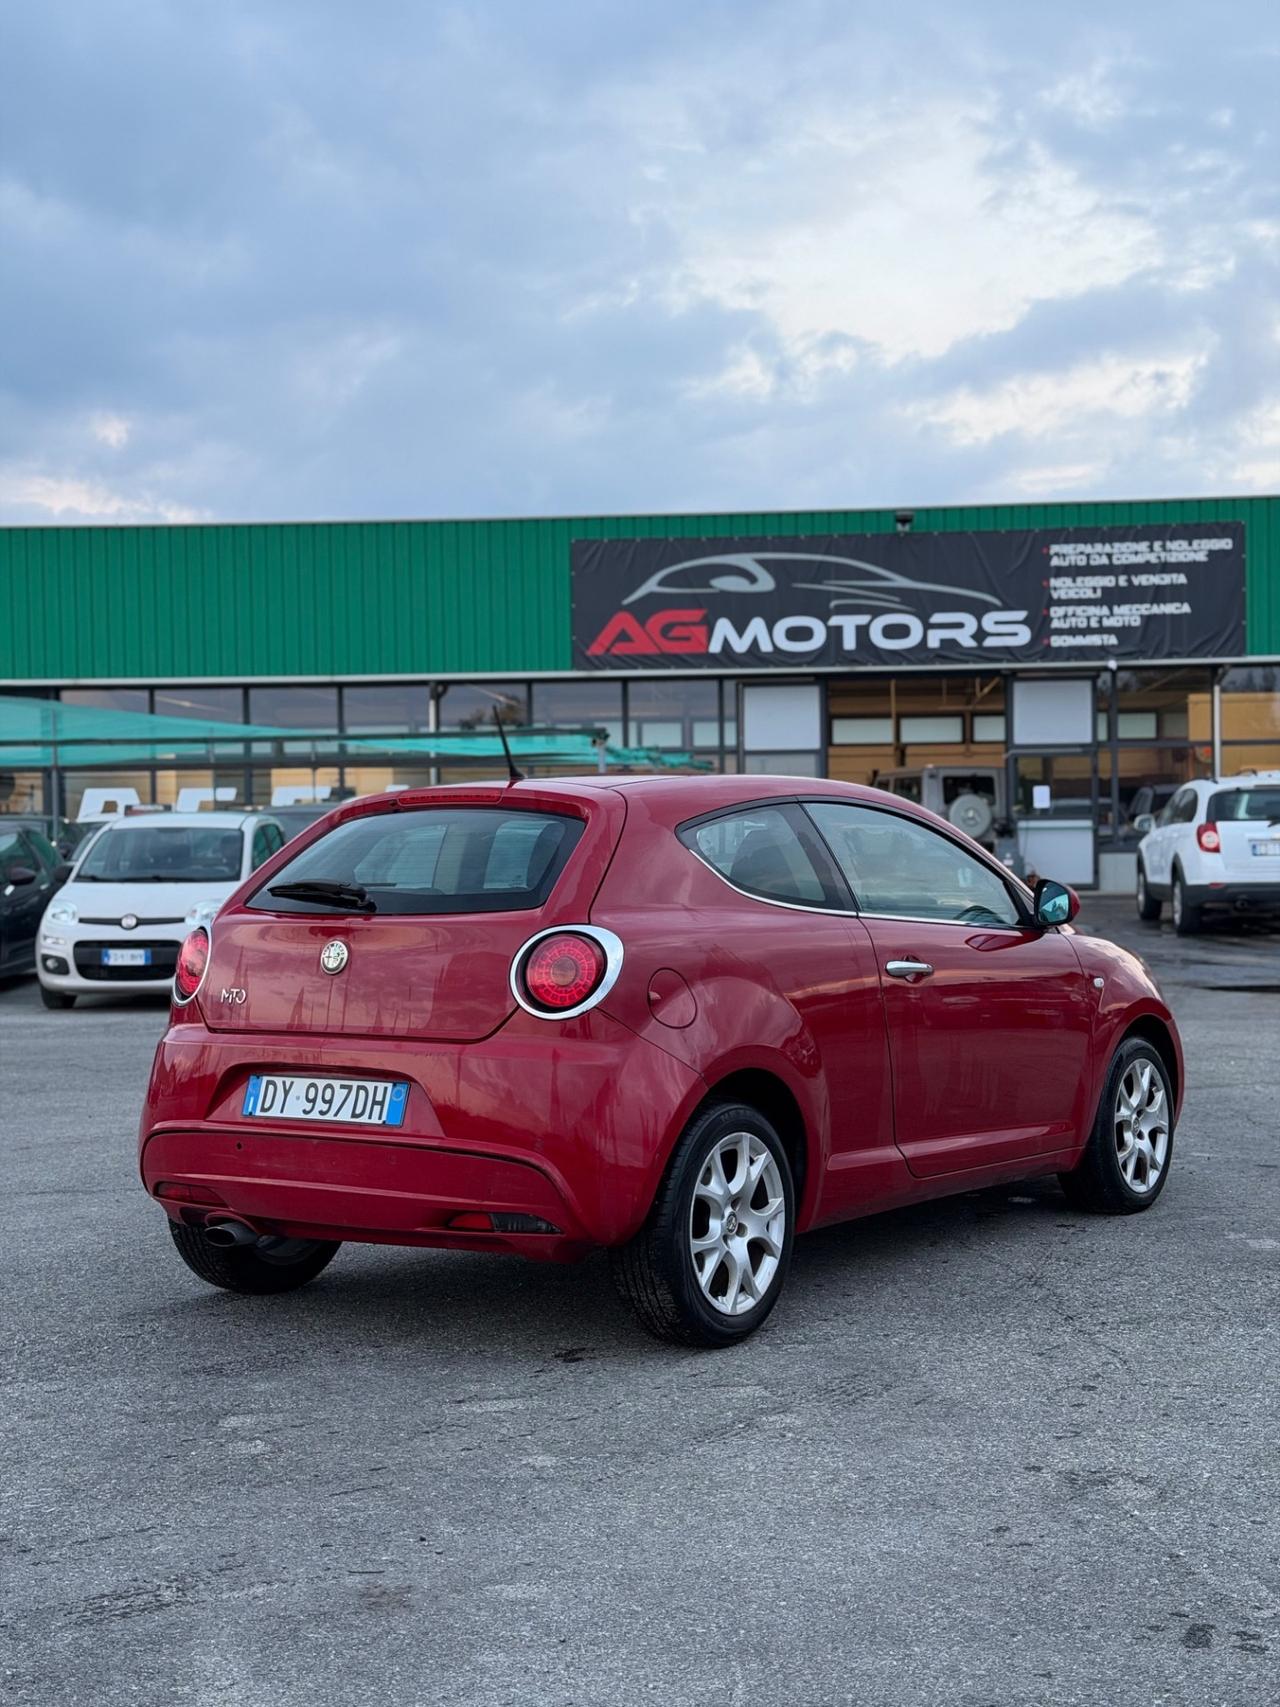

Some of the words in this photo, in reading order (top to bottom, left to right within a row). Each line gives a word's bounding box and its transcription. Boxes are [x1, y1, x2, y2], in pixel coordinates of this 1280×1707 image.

[1153, 541, 1163, 552] E
[1166, 538, 1233, 551] NOLEGGIO
[1050, 554, 1087, 566] AUTO
[1089, 554, 1109, 566] DA
[1112, 550, 1209, 565] COMPETIZIONE
[1050, 575, 1115, 588] NOLEGGIO
[1118, 575, 1128, 586] E
[1131, 573, 1188, 586] VENDITA
[1050, 588, 1102, 599] VEICOLI
[1050, 605, 1110, 618] OFFICINA
[1113, 602, 1192, 616] MECCANICA
[1050, 617, 1087, 629] AUTO
[1090, 616, 1100, 628] E
[1102, 615, 1141, 627] MOTO
[1050, 634, 1118, 647] GOMMISTA
